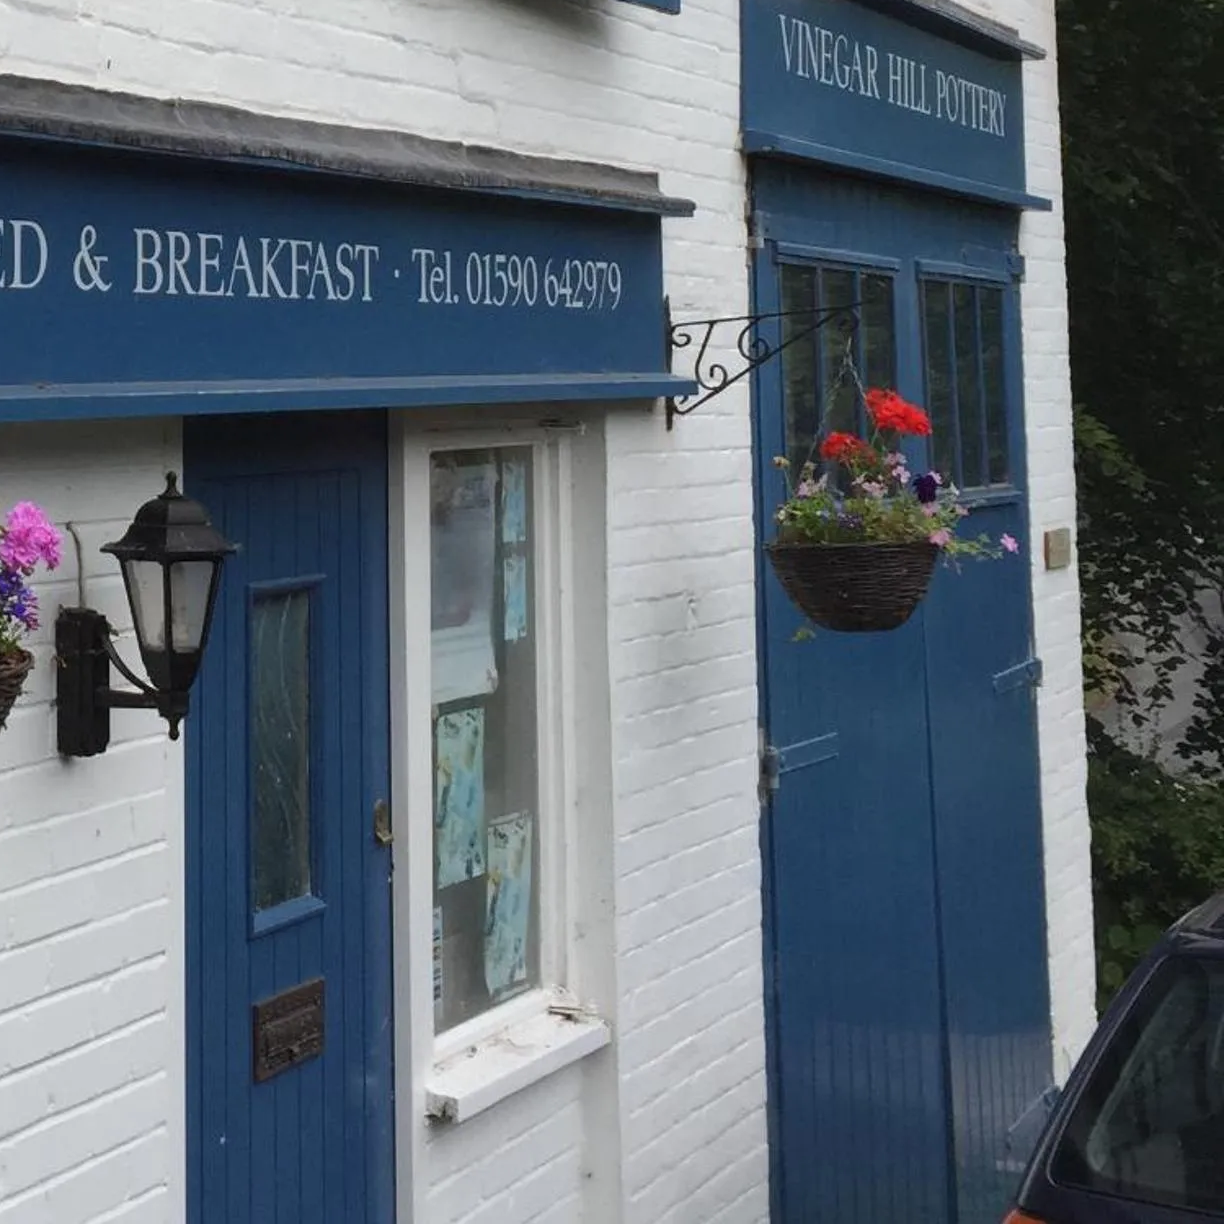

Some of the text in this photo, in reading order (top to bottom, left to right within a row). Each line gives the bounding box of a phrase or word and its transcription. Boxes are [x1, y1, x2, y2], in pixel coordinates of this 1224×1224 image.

[779, 14, 1006, 137] VINEGAR HILL POTTERY
[73, 225, 112, 292] &
[133, 228, 379, 301] BREAKFAST
[412, 249, 460, 304] Tel.
[466, 252, 537, 306] 01590
[544, 257, 622, 310] 642979
